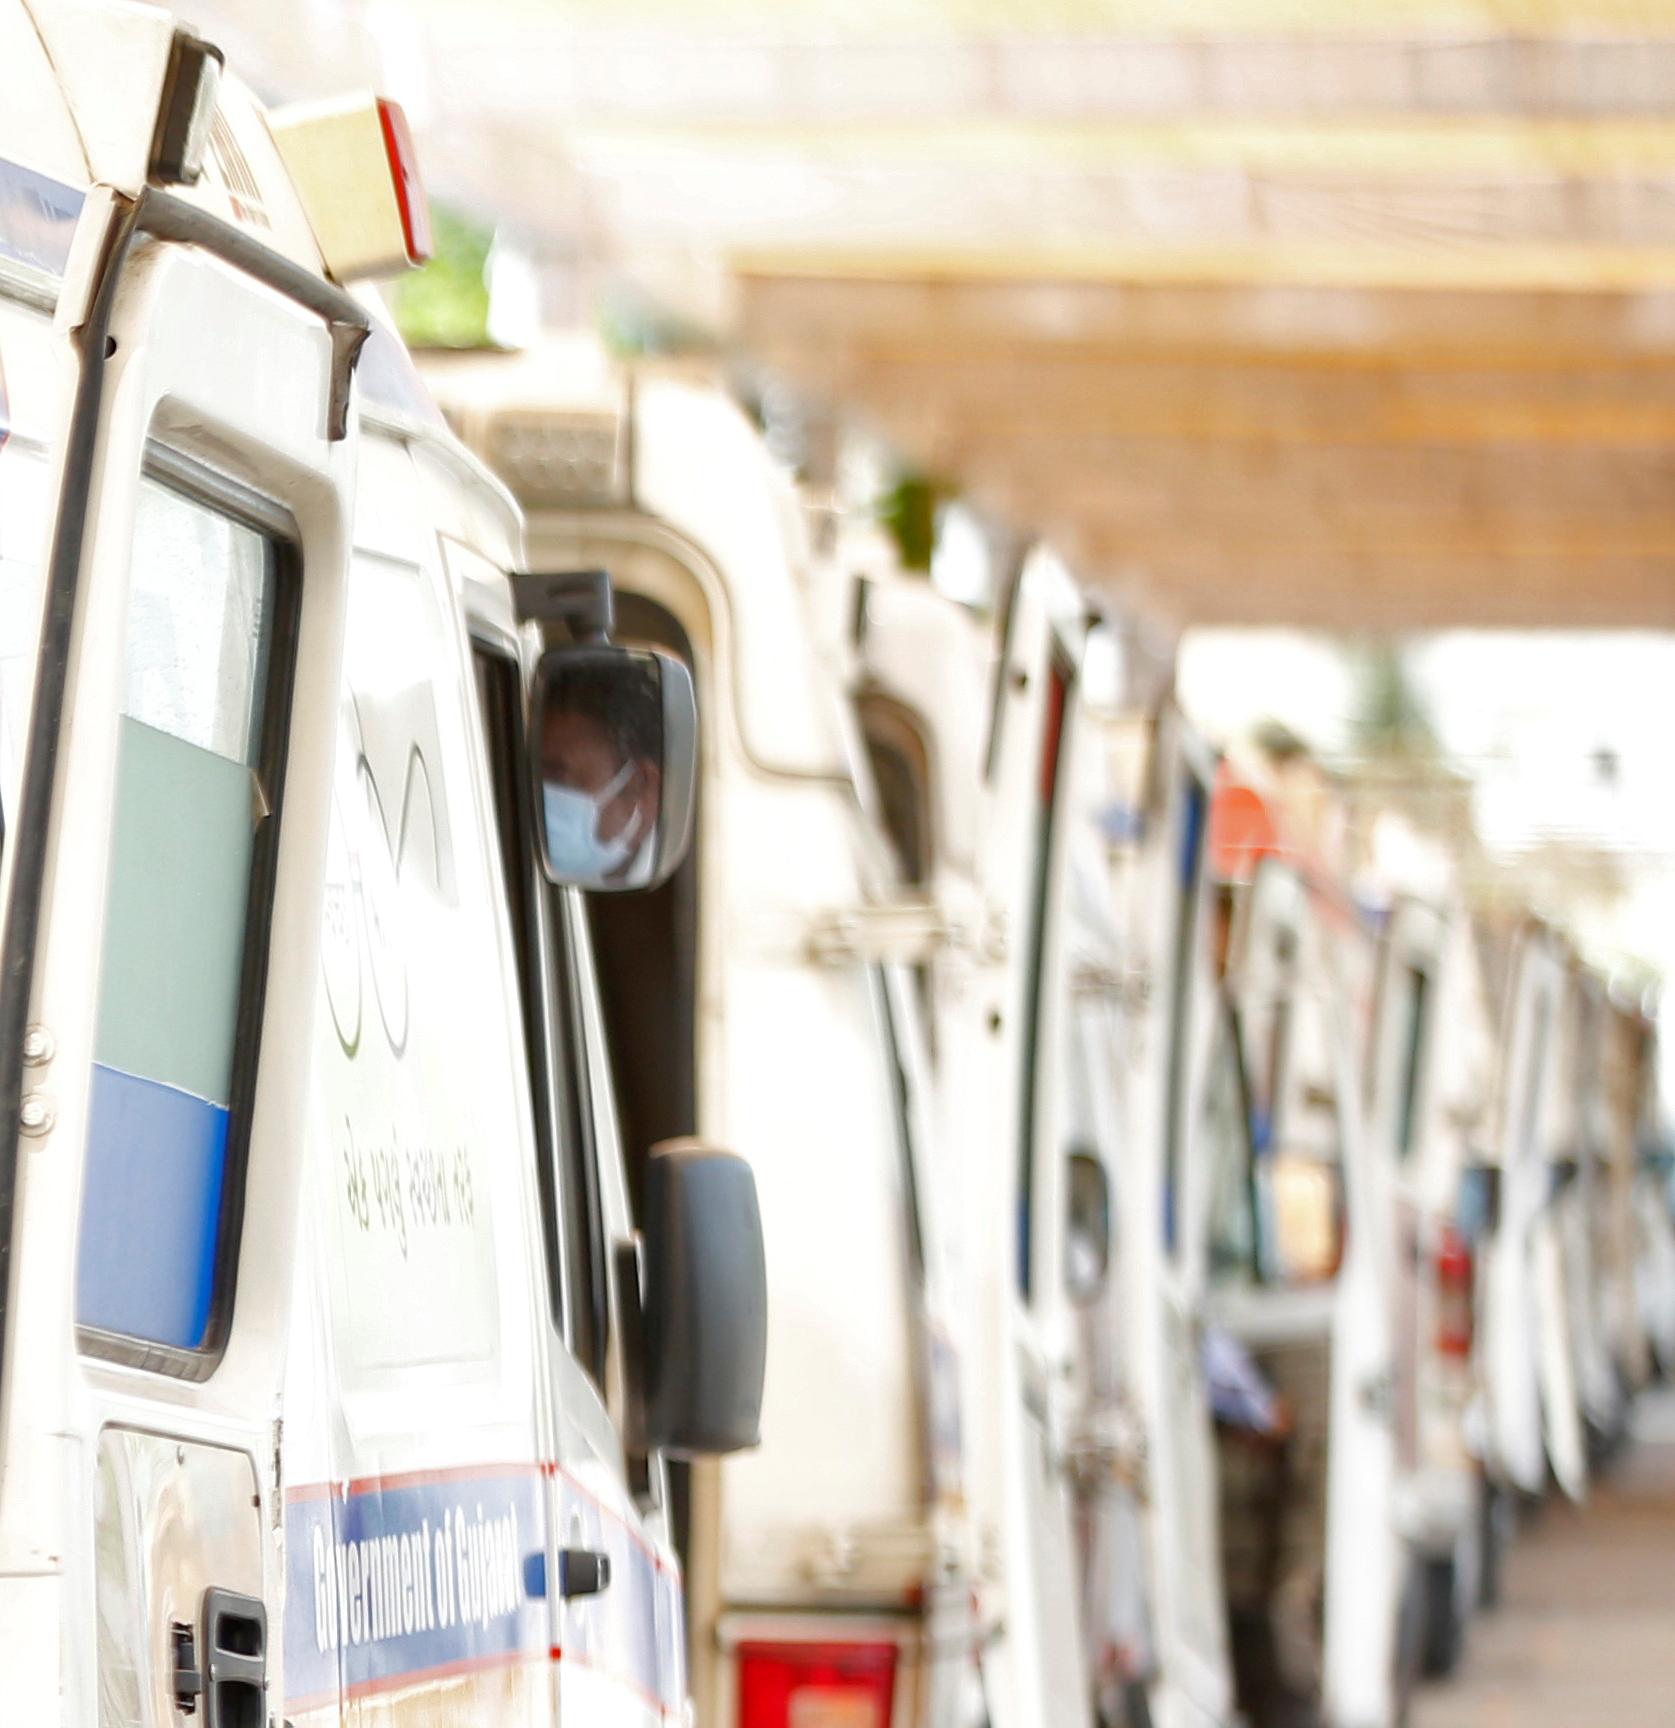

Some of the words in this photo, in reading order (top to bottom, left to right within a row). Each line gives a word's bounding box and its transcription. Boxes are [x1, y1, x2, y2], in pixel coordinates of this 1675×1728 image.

[312, 1517, 435, 1655] Government
[434, 1507, 457, 1630] of
[455, 1502, 522, 1633] Gujarat
